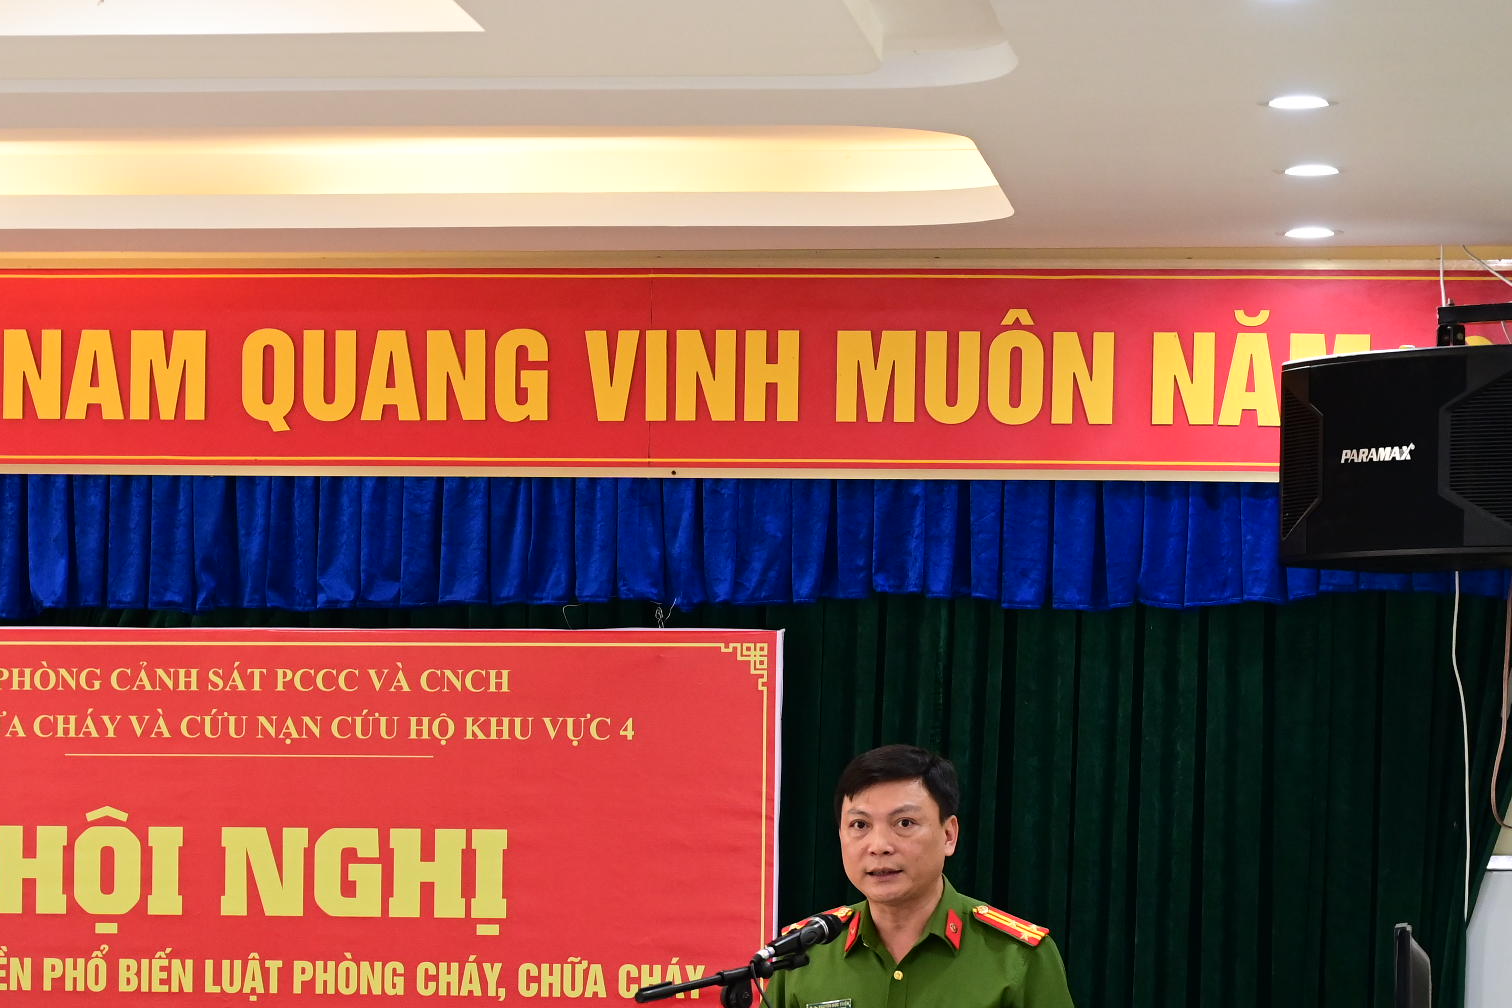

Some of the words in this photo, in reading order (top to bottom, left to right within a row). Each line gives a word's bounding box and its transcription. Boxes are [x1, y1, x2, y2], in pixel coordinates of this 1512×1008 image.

[2, 329, 207, 421] NAM
[241, 328, 549, 432] QUANG
[584, 330, 800, 422] VINH
[835, 308, 1115, 425] MUÔN
[1151, 309, 1371, 427] NĂ
[1340, 443, 1416, 463] PARAMAX
[110, 661, 199, 691] CẢNH
[208, 661, 267, 691] SÁT
[275, 668, 359, 692] PCCC
[367, 662, 412, 692] VÀ
[419, 669, 511, 693] CNCH
[33, 709, 122, 738] CHÁY
[128, 709, 172, 738] VÀ
[180, 709, 248, 739] CỨU
[256, 716, 322, 745] NẠN
[330, 710, 400, 740] CỨU
[408, 713, 455, 746] HỘ
[465, 717, 534, 740] KHU
[542, 713, 611, 747] VỰC
[619, 717, 635, 741] 4
[220, 827, 508, 936] NGHỊ
[43, 944, 109, 993] PHỔ
[118, 947, 194, 993] BIẾN
[204, 952, 283, 1002] LUẬT
[293, 952, 405, 996] PHÒNG
[416, 954, 506, 1002] CHÁY,
[517, 956, 607, 998] CHỮA
[618, 957, 706, 999] CHÁY
